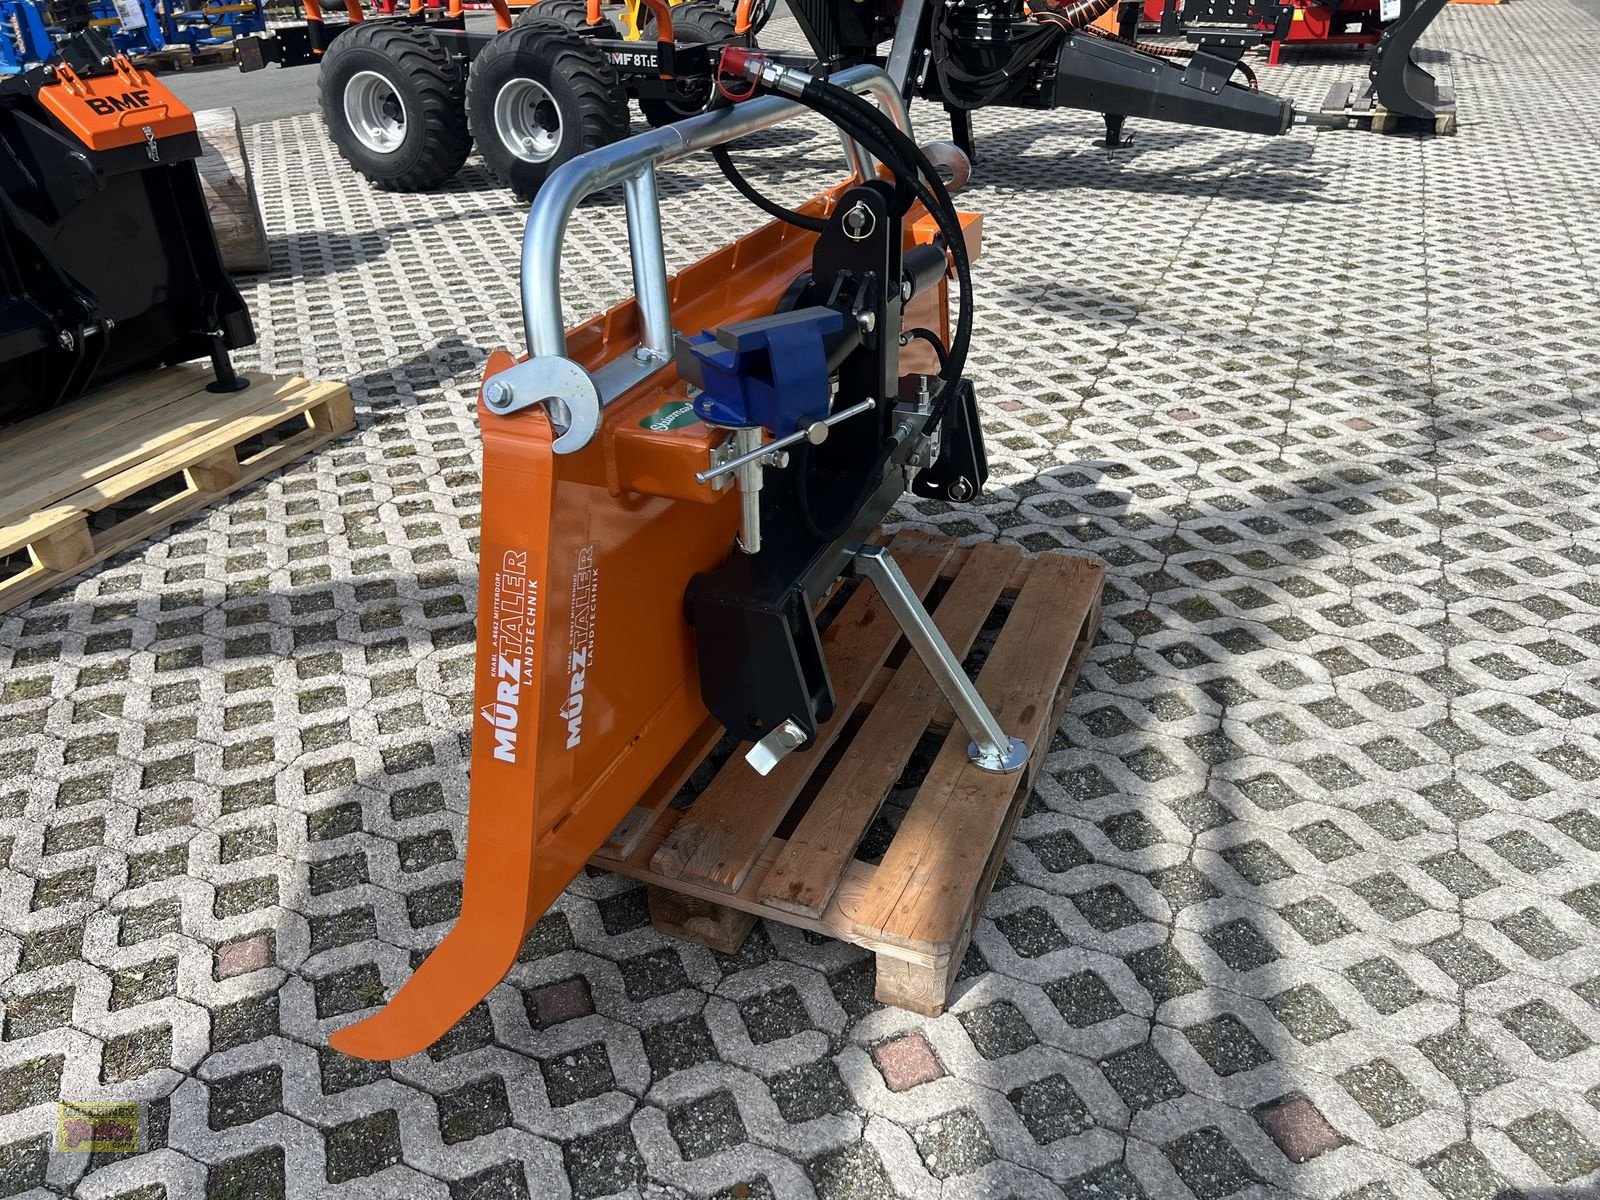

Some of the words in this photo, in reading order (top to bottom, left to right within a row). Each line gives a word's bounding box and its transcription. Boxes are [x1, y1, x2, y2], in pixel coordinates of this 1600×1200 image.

[84, 89, 151, 116] BMF
[493, 572, 502, 620] MITTERDORF
[491, 621, 499, 647] A-8662
[523, 579, 538, 686] LANDTECHNIK
[587, 567, 599, 667] LANDTECHNIK
[490, 653, 498, 678] KNABL
